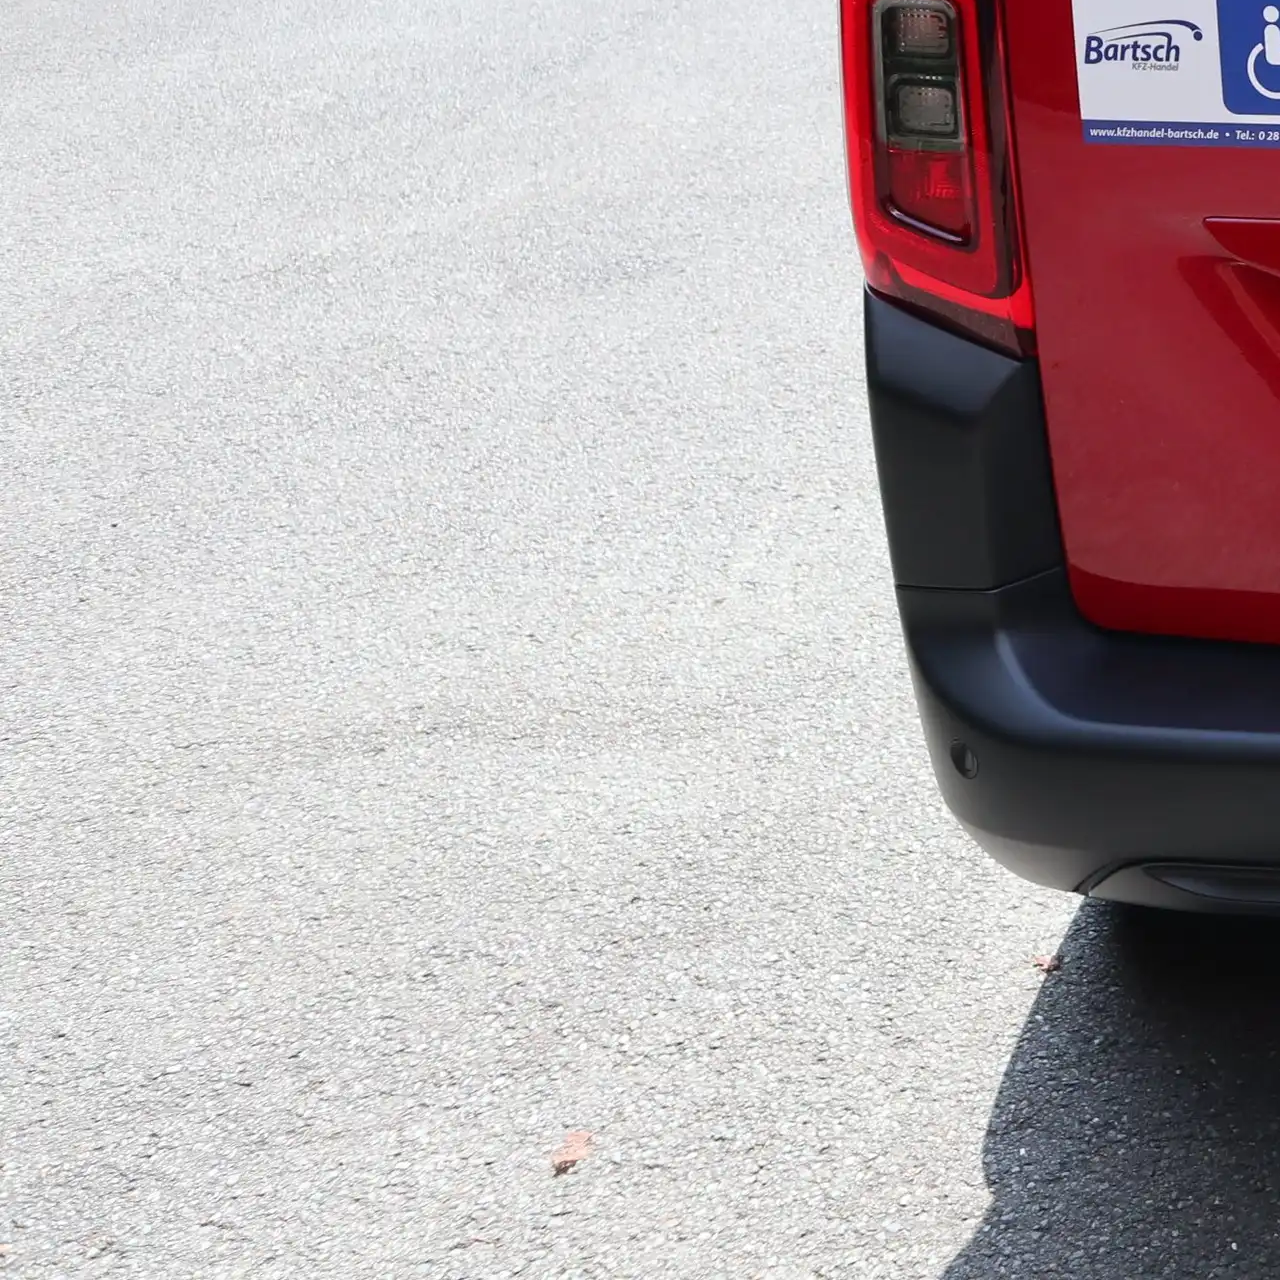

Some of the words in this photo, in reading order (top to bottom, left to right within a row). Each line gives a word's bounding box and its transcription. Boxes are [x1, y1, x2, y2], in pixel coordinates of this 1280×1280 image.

[1084, 32, 1180, 65] Bartsch
[1132, 62, 1180, 72] KFZ-Handel
[1089, 126, 1220, 140] www.kfzhandel-bartsch.de
[1235, 129, 1255, 141] Tel.:
